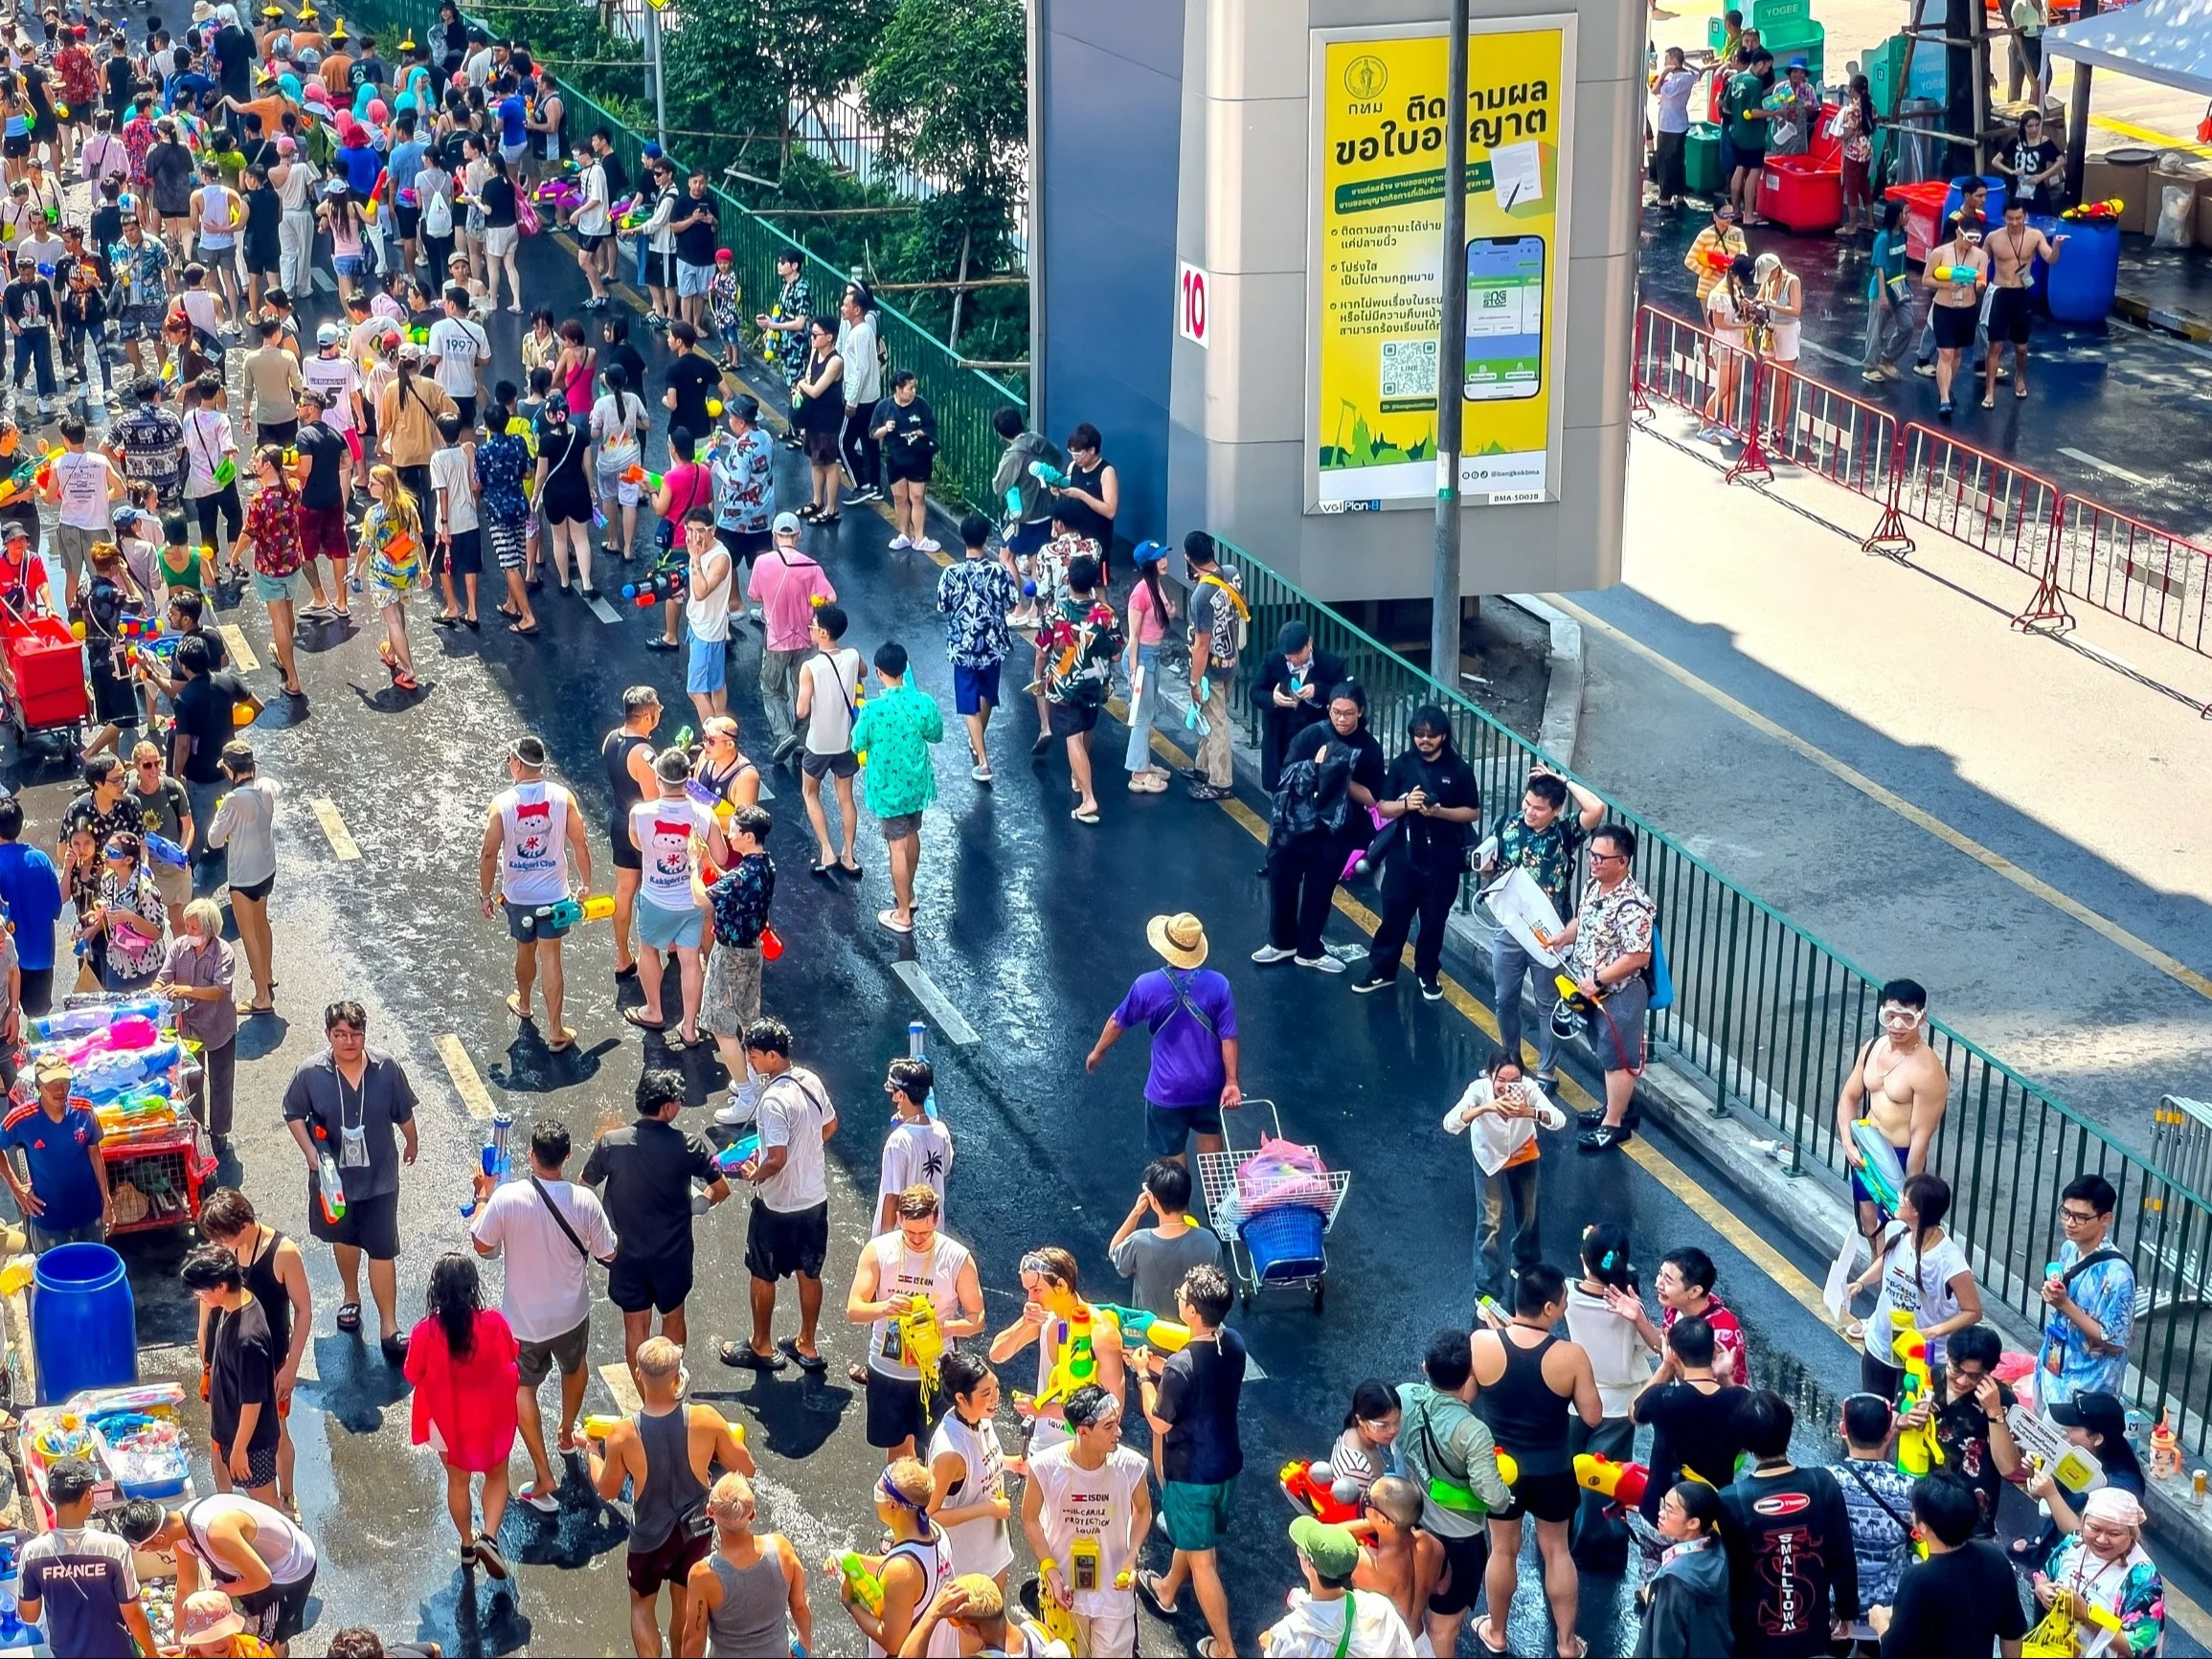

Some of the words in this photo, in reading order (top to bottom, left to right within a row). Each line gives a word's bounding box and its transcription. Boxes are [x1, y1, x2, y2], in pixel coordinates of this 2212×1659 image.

[1767, 4, 1798, 17] YOGEE
[1921, 78, 1946, 91] YOGE
[1348, 102, 1383, 115] กทม
[1407, 80, 1547, 123] ติดามผล
[1336, 108, 1546, 166] ขอใบอญาต
[1342, 219, 1441, 235] ติดตามสถานะได้ง่าย
[1342, 234, 1397, 249] แค่ปลายนิ้ว
[1341, 259, 1378, 273] โปร่งใส
[1183, 269, 1206, 339] 10
[1341, 293, 1443, 309] หากไม่พบเรื่องในระบ
[446, 339, 473, 352] 1997
[325, 387, 344, 409] 5
[539, 860, 557, 868] Club
[1088, 1493, 1109, 1502] ISDIN
[42, 1562, 106, 1580] FRANCE
[1778, 1534, 1796, 1632] SMALLTOWN
